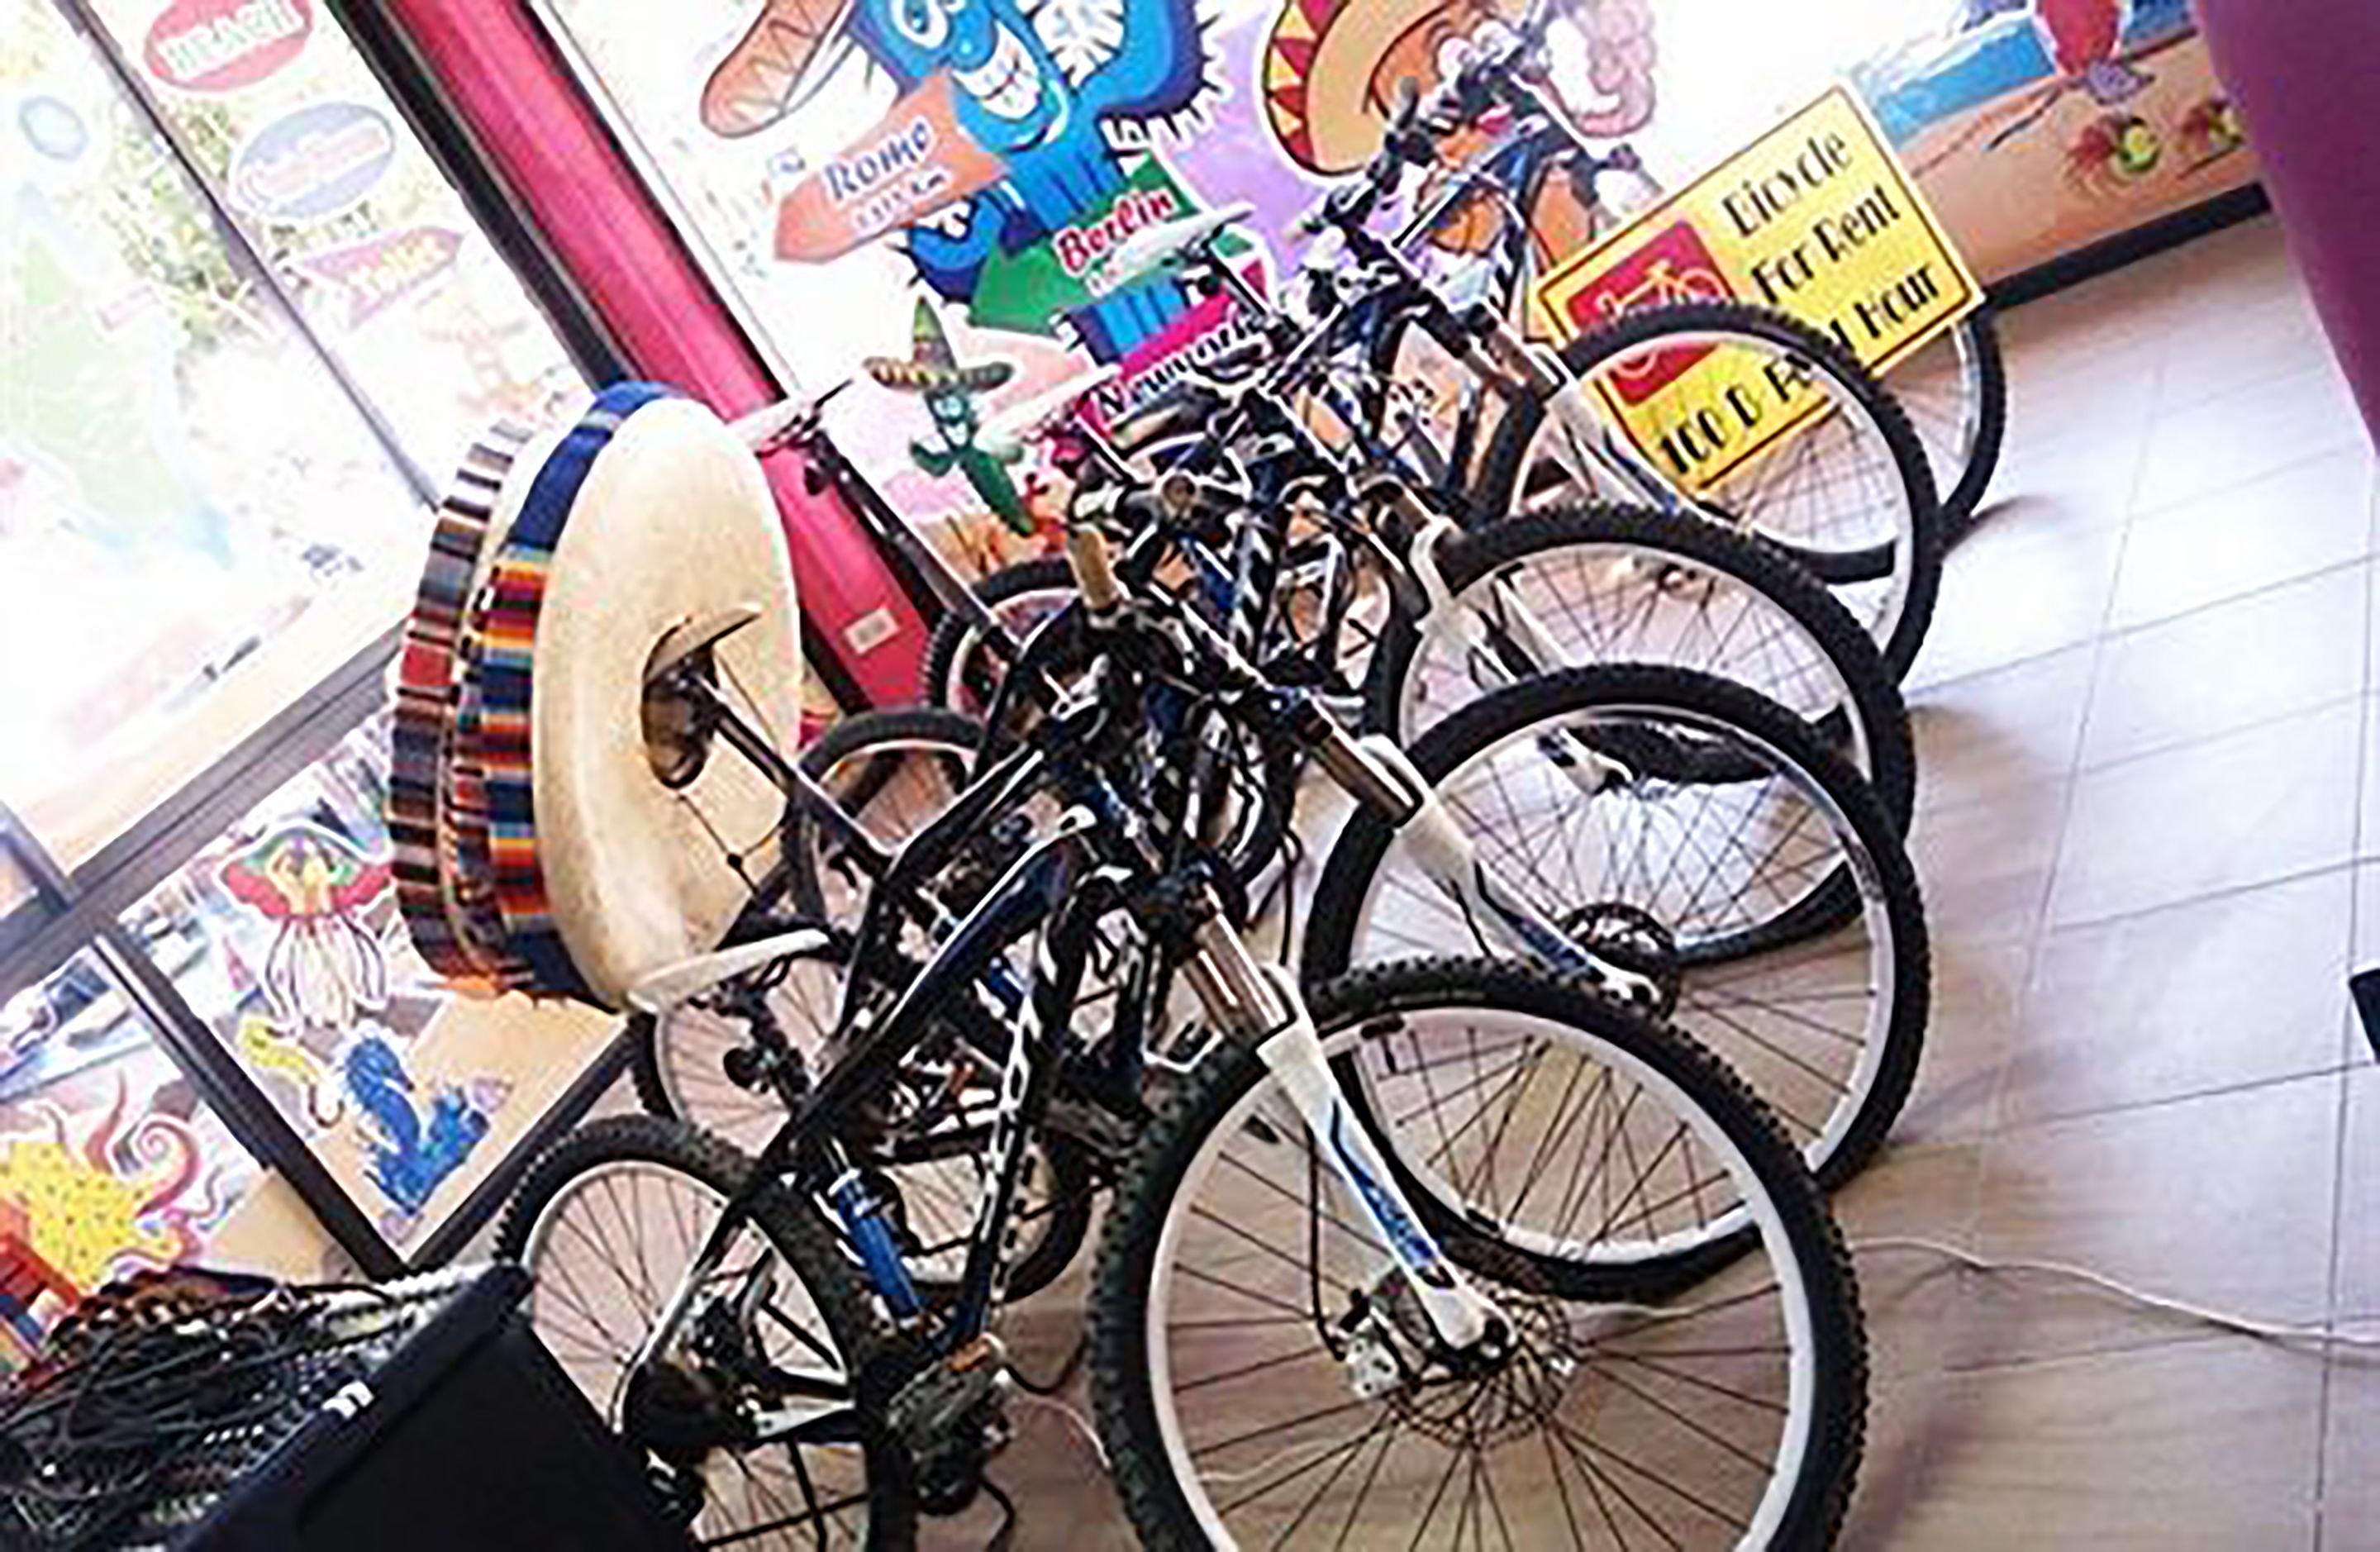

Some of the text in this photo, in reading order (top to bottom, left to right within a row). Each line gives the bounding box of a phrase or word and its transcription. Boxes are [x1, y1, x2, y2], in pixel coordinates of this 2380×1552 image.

[826, 121, 932, 202] Rome
[1721, 131, 1854, 238] Bicycle
[1057, 188, 1177, 274] Berlin
[1749, 183, 1901, 303] For Rent
[1661, 397, 1727, 474] 100
[1854, 263, 1940, 339] Hour
